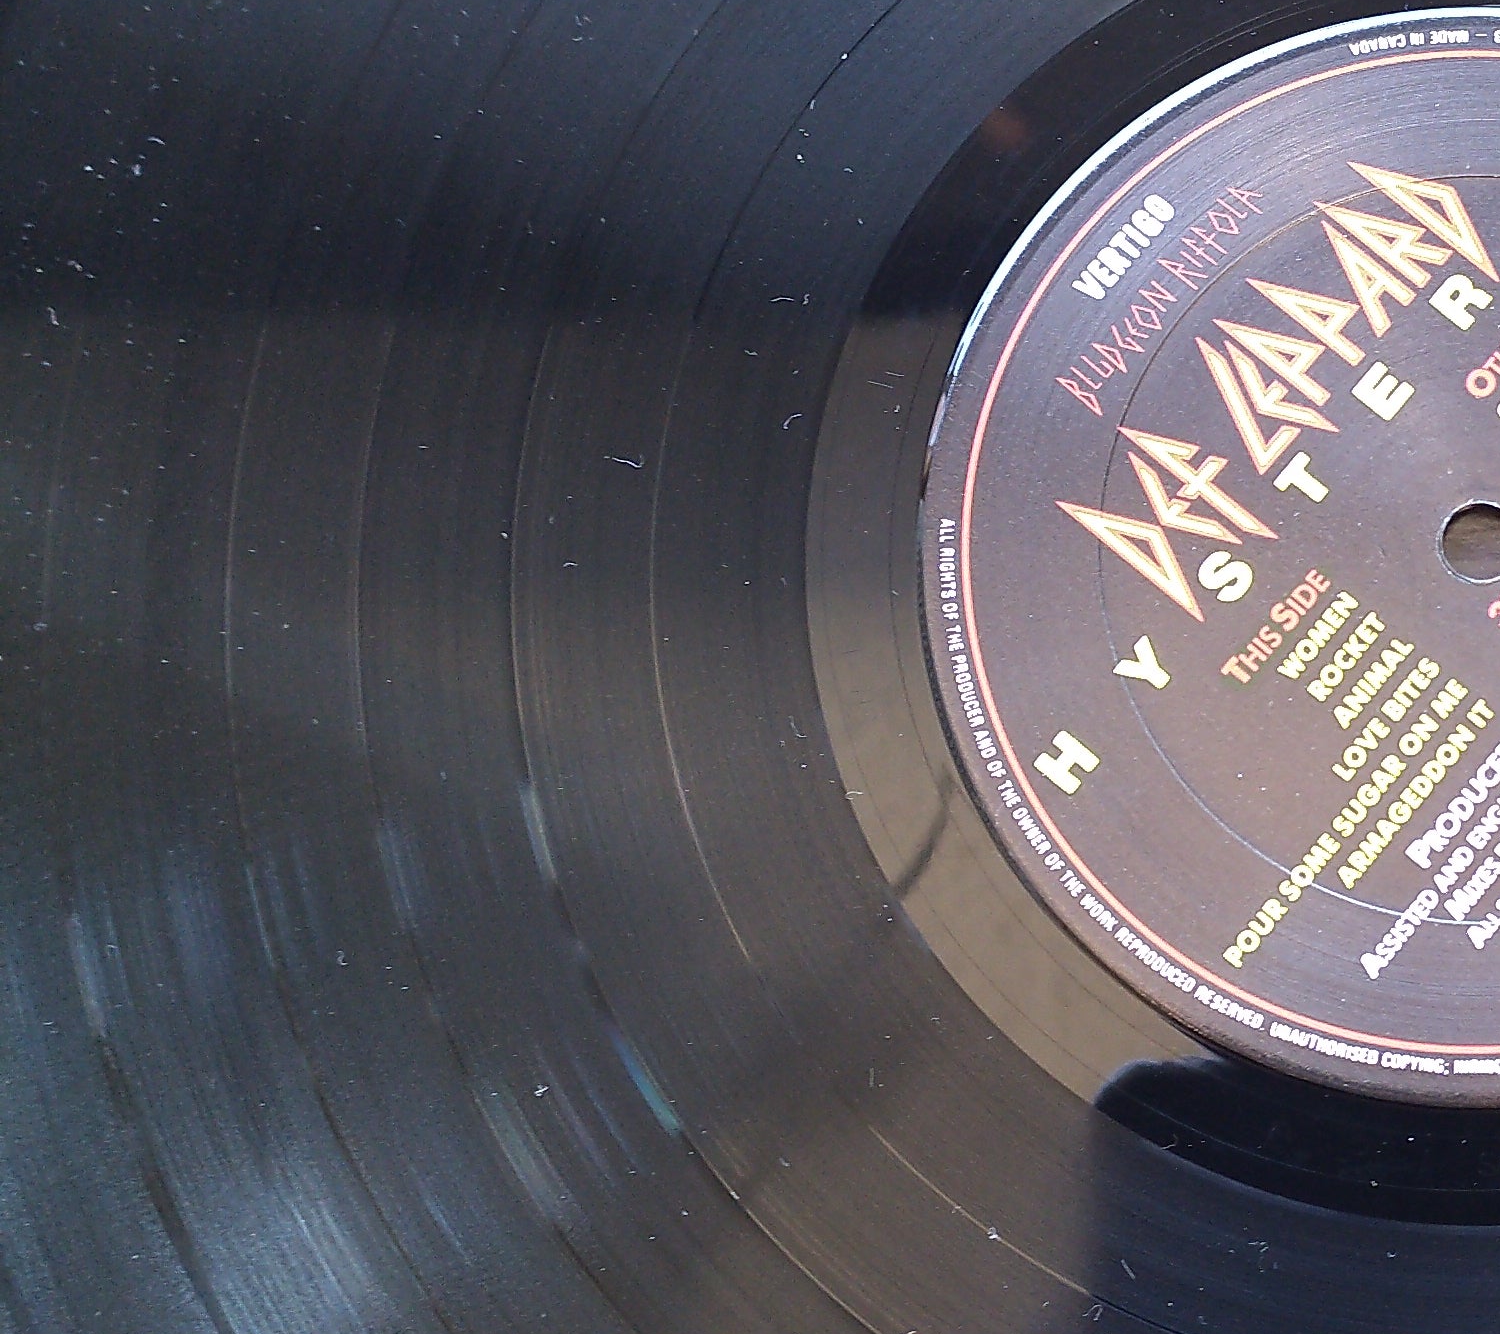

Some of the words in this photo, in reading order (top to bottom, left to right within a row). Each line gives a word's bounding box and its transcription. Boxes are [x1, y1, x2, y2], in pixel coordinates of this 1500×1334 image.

[1071, 191, 1179, 299] VERTIGO
[1158, 186, 1264, 290] RIFFOLA
[1055, 426, 1282, 622] DEF
[1195, 161, 1500, 475] LEPPARD
[938, 518, 955, 542] ALL
[938, 547, 956, 598] RIGHTS
[941, 602, 959, 619] OF
[945, 624, 964, 651] THE
[1220, 624, 1282, 683] THIS
[1269, 569, 1330, 631] SIDE
[1276, 591, 1358, 678] WOMEN
[950, 654, 984, 727] PRODUCER
[1306, 611, 1385, 701] ROCKET
[1333, 639, 1414, 729] ANIMAL
[973, 730, 996, 758] AND
[1331, 717, 1390, 781] LOVE
[1380, 657, 1439, 721] BITES
[986, 760, 1006, 777] OF
[997, 779, 1021, 807] THE
[1337, 723, 1475, 888] ARMAGEDDON
[1466, 698, 1494, 728] IT
[1012, 807, 1051, 854] OWNER
[1222, 898, 1288, 967] POUR
[1278, 832, 1340, 901] SOME
[1332, 754, 1406, 837] SUGAR
[1398, 713, 1439, 755] ON
[1430, 678, 1468, 719] ME
[1044, 852, 1065, 870] OF
[1059, 869, 1086, 897] THE
[1079, 893, 1118, 931] WORK
[1359, 889, 1438, 979] ASSISTED
[1433, 845, 1474, 893] AND
